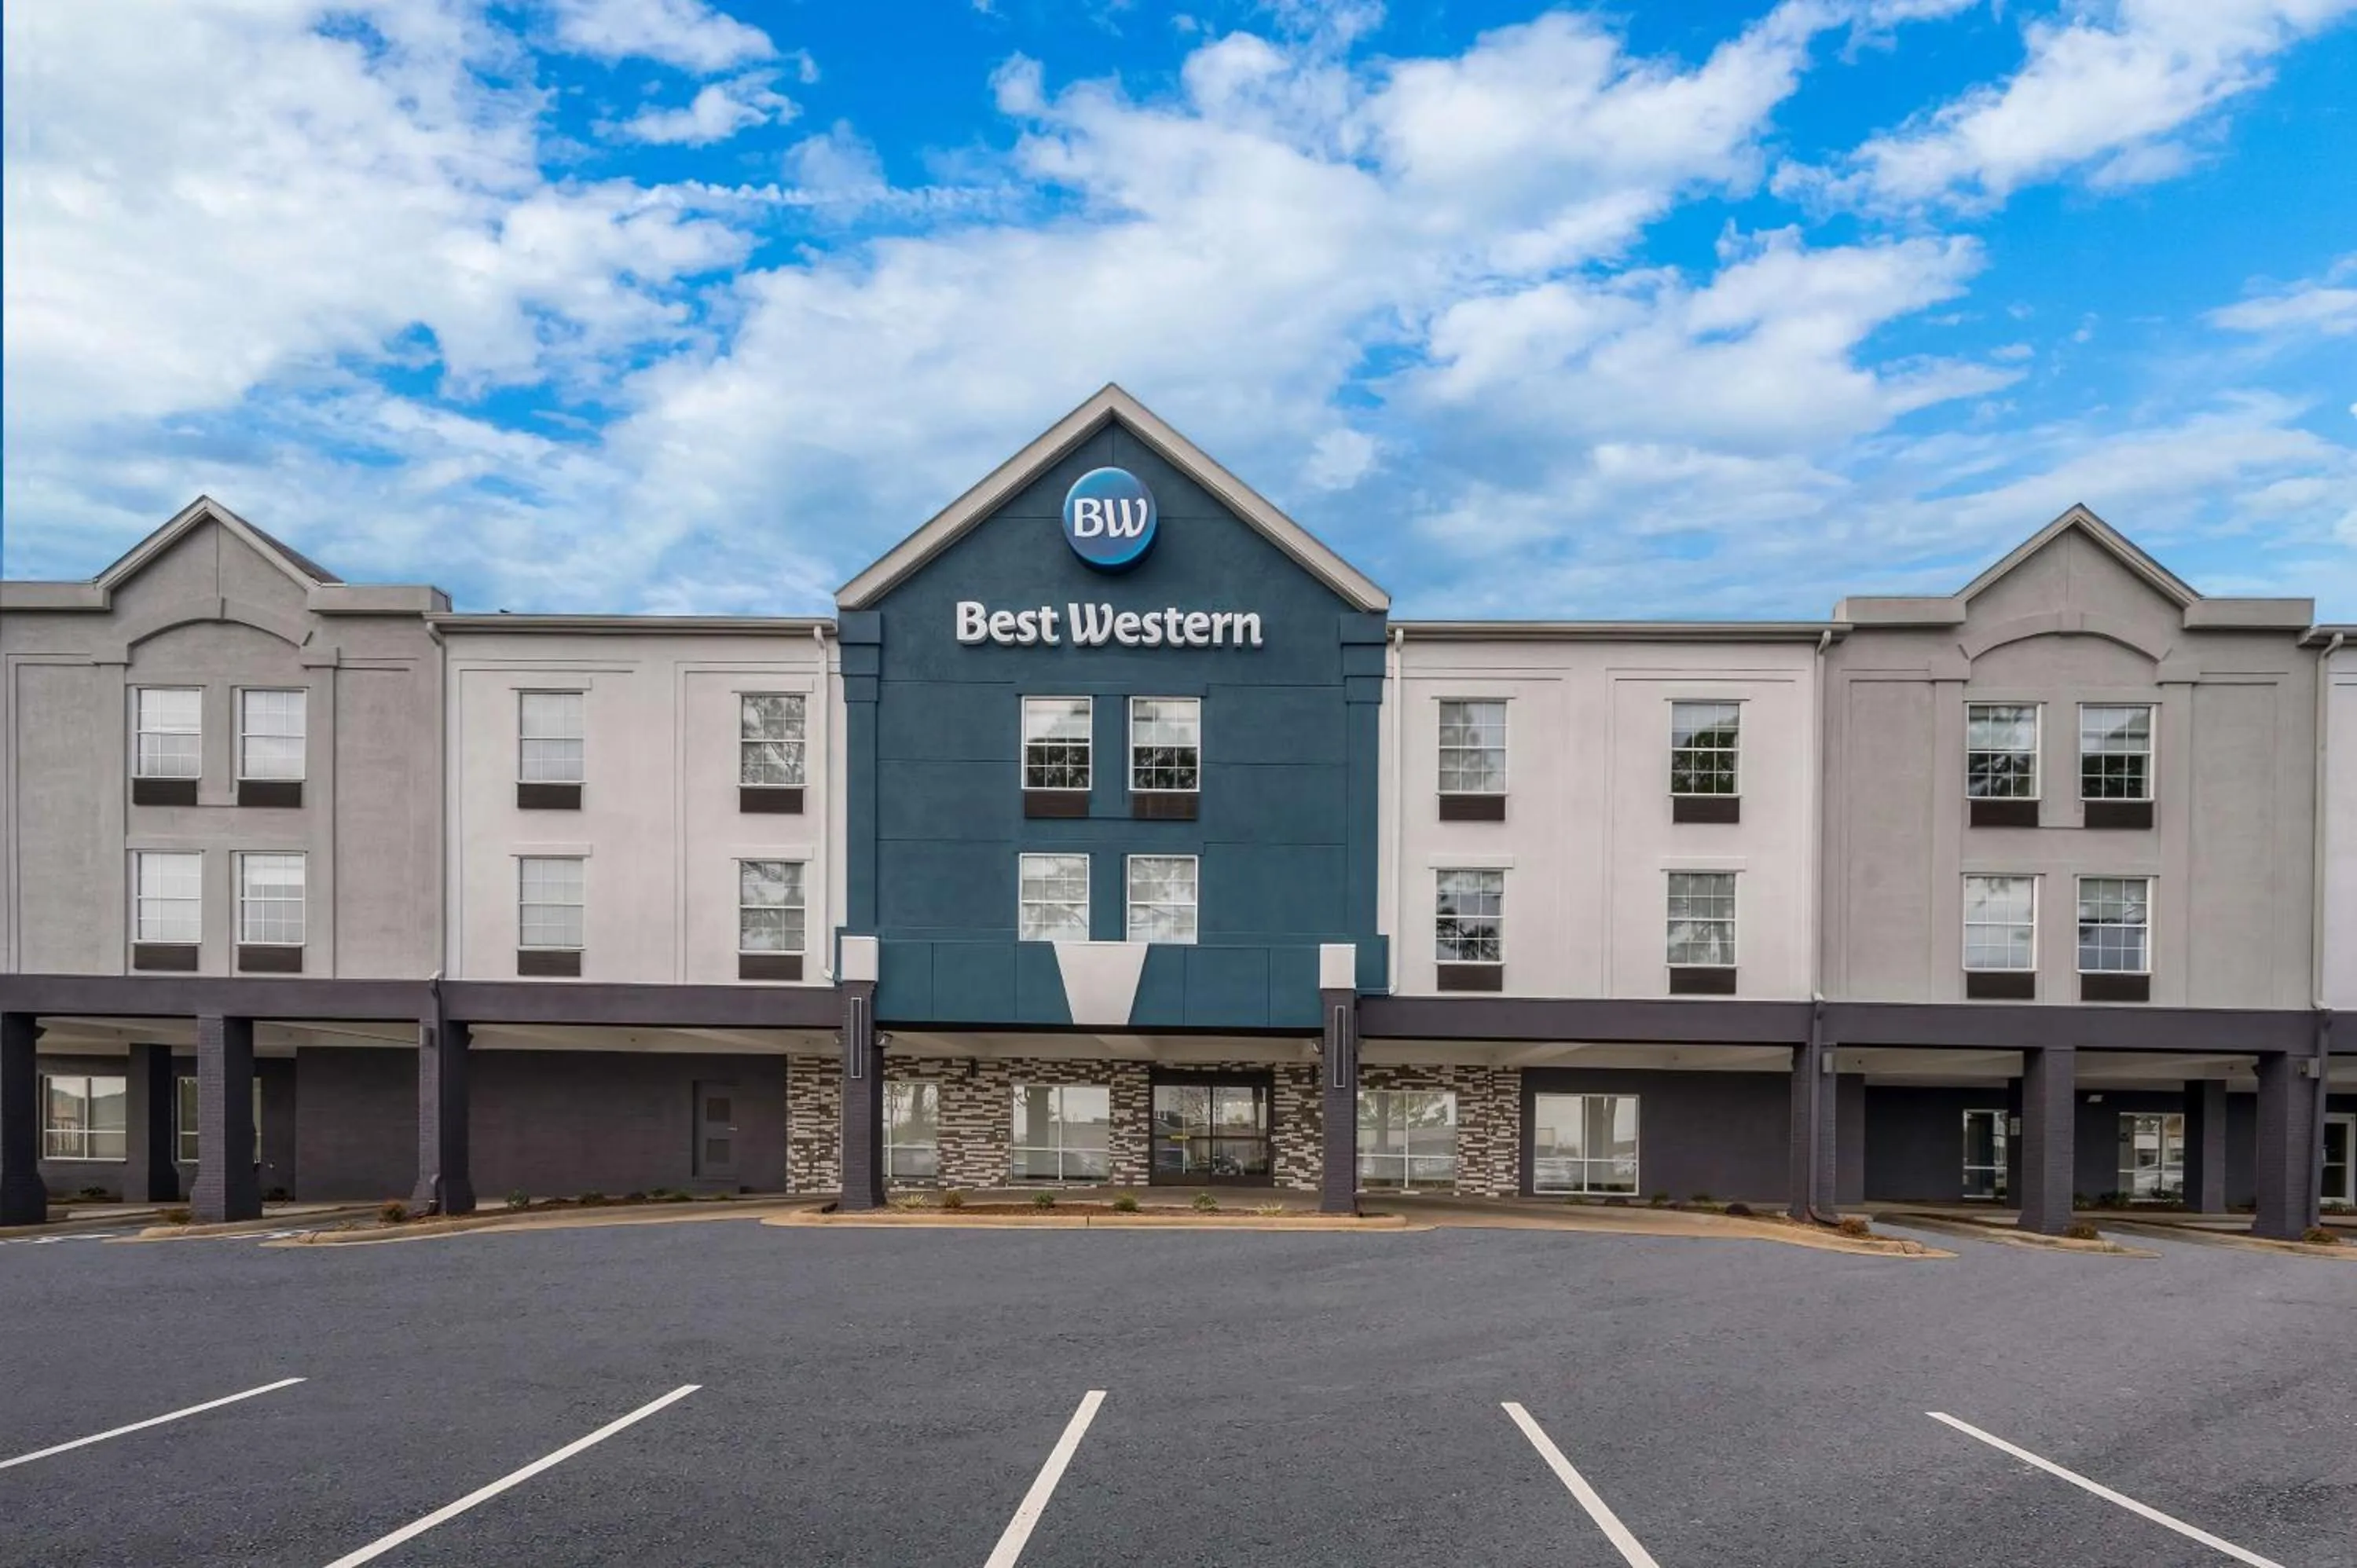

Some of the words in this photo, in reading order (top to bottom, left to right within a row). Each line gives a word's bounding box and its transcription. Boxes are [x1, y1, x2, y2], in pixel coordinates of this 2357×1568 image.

[1073, 497, 1147, 537] BW
[956, 601, 1059, 645] Best
[1068, 603, 1263, 647] Western
